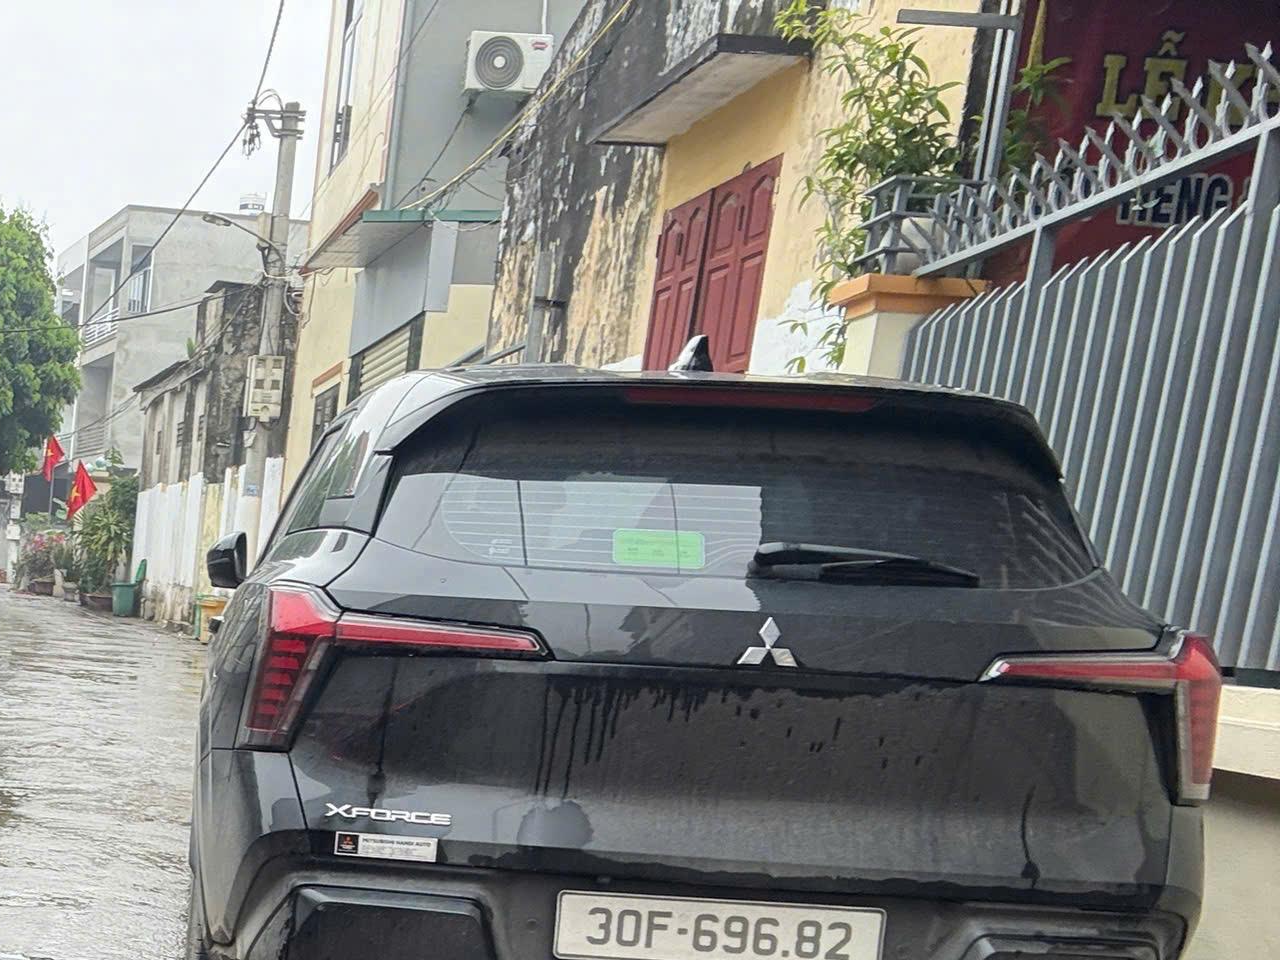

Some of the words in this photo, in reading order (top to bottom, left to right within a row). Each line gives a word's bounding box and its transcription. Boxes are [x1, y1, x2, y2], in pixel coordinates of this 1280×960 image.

[1096, 30, 1188, 121] LỄ
[1206, 61, 1280, 127] K
[325, 803, 452, 825] XFORCE
[586, 907, 852, 960] 30F-696.82
